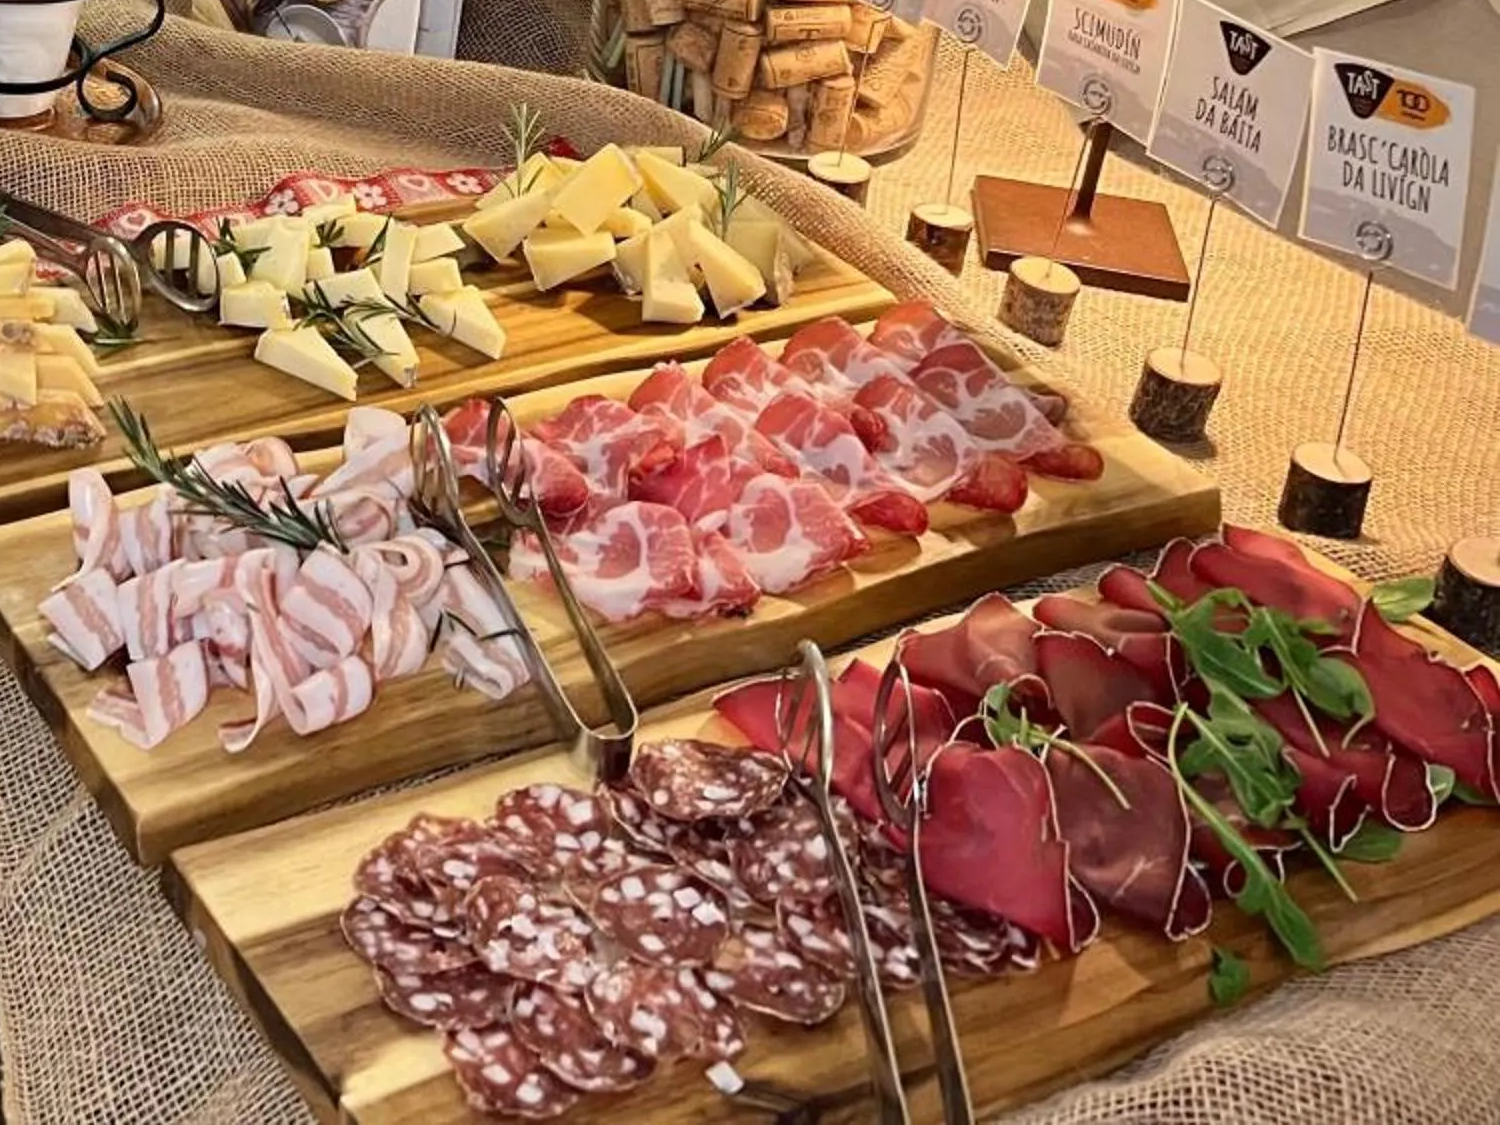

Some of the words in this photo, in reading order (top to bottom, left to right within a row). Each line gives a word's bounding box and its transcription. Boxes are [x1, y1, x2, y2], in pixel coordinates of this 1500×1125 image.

[1229, 30, 1260, 60] TAST
[1348, 70, 1380, 100] TAST
[1195, 98, 1215, 126] DA
[1343, 160, 1364, 192] DA
